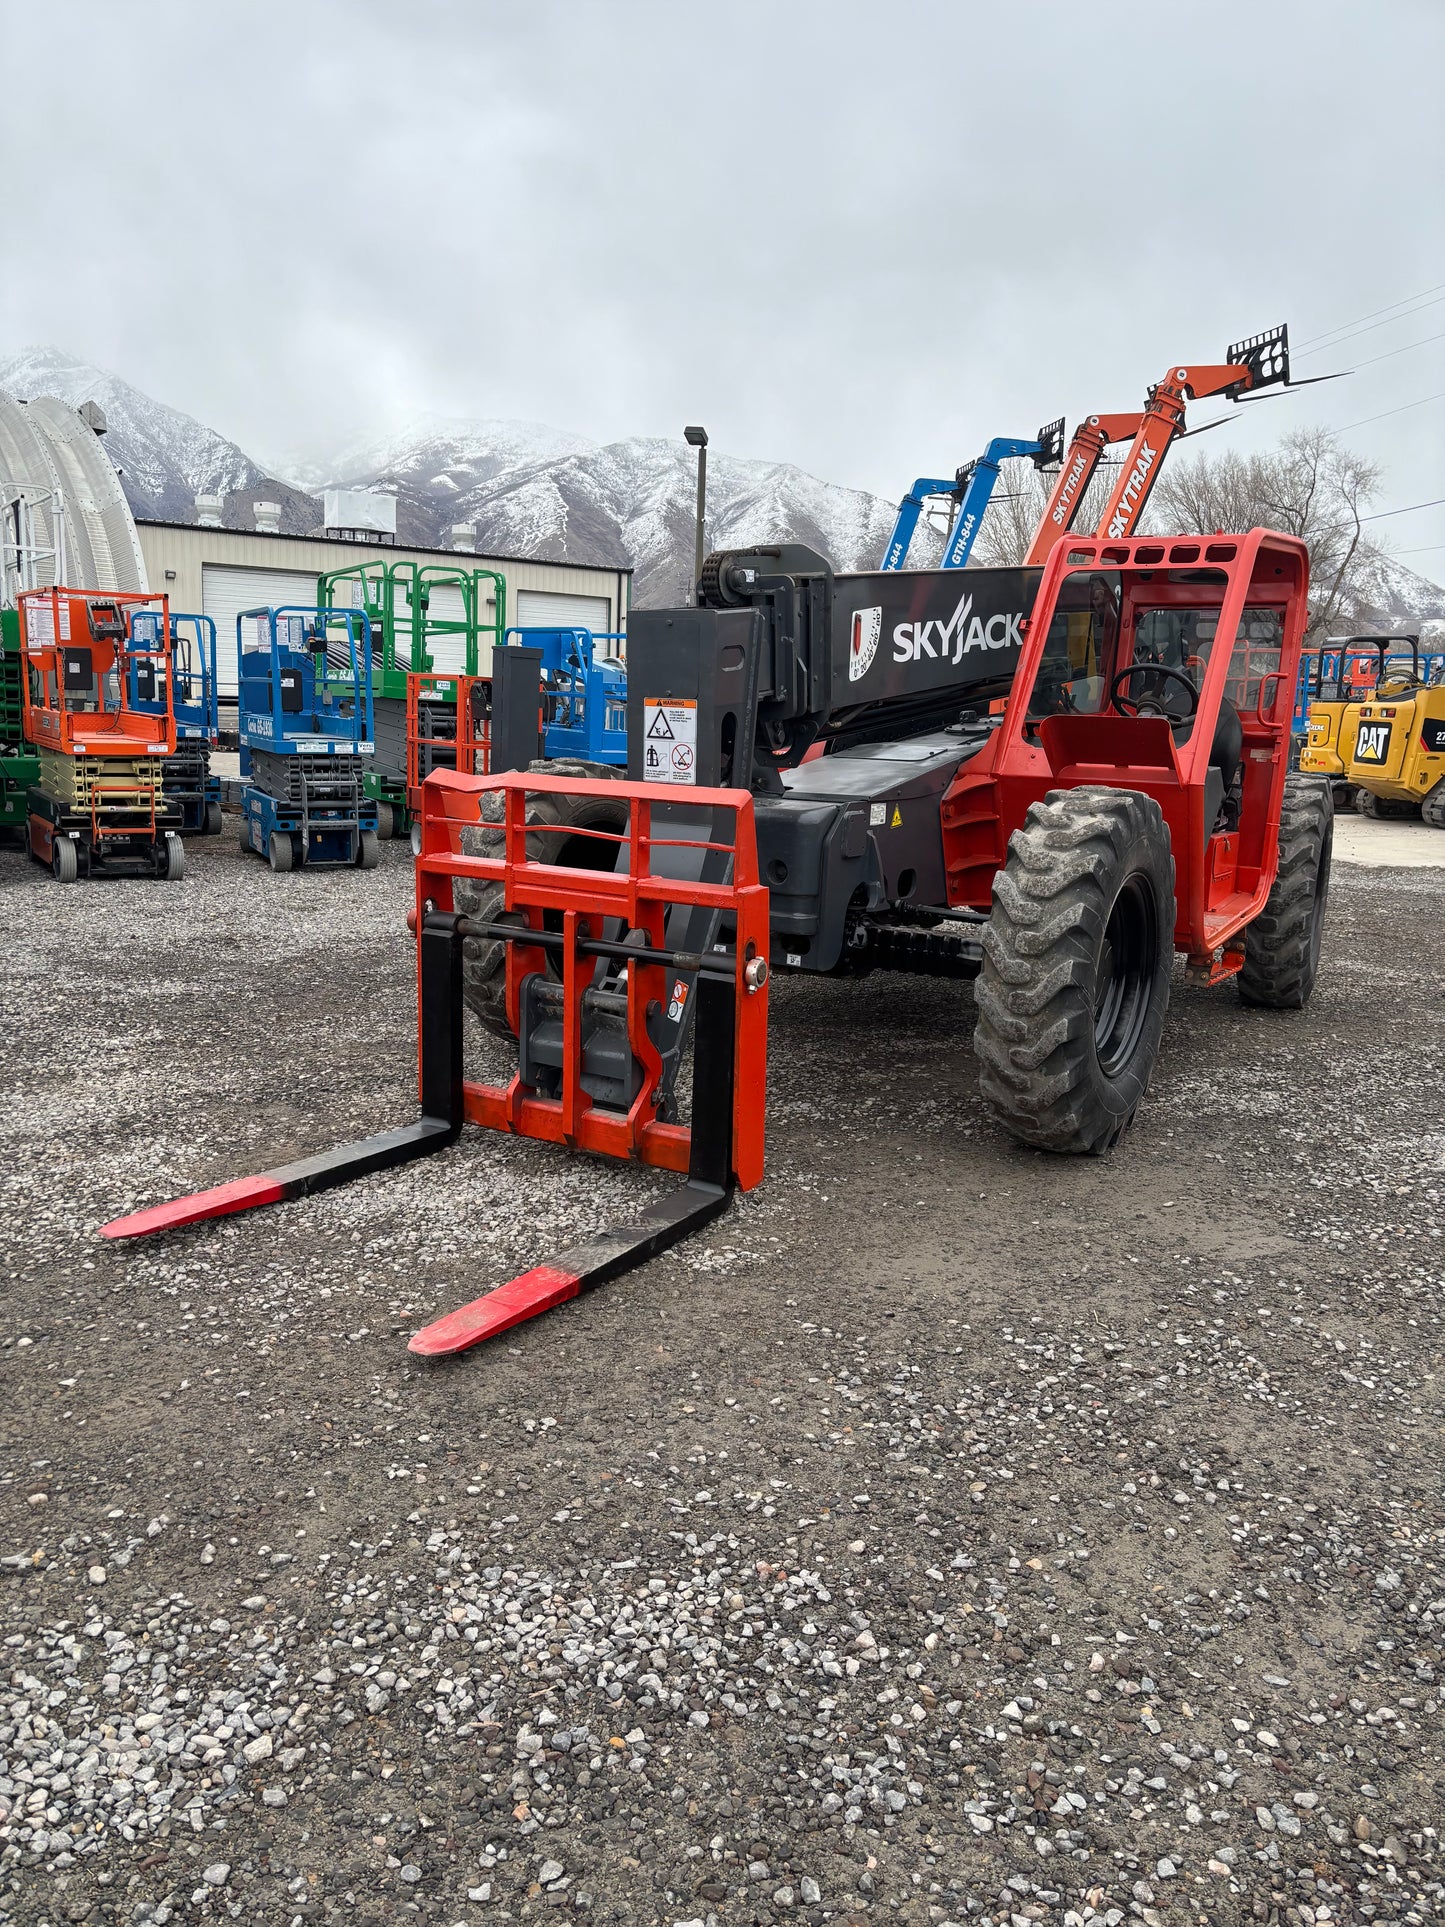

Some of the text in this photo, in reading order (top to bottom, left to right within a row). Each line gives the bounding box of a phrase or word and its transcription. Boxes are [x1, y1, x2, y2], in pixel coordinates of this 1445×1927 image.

[1053, 453, 1088, 525] SKYTRAK
[1108, 439, 1157, 538] SKYTRAK
[951, 513, 976, 565] GTH-844
[892, 593, 1023, 665] SKYJACK
[1357, 727, 1389, 759] CAT
